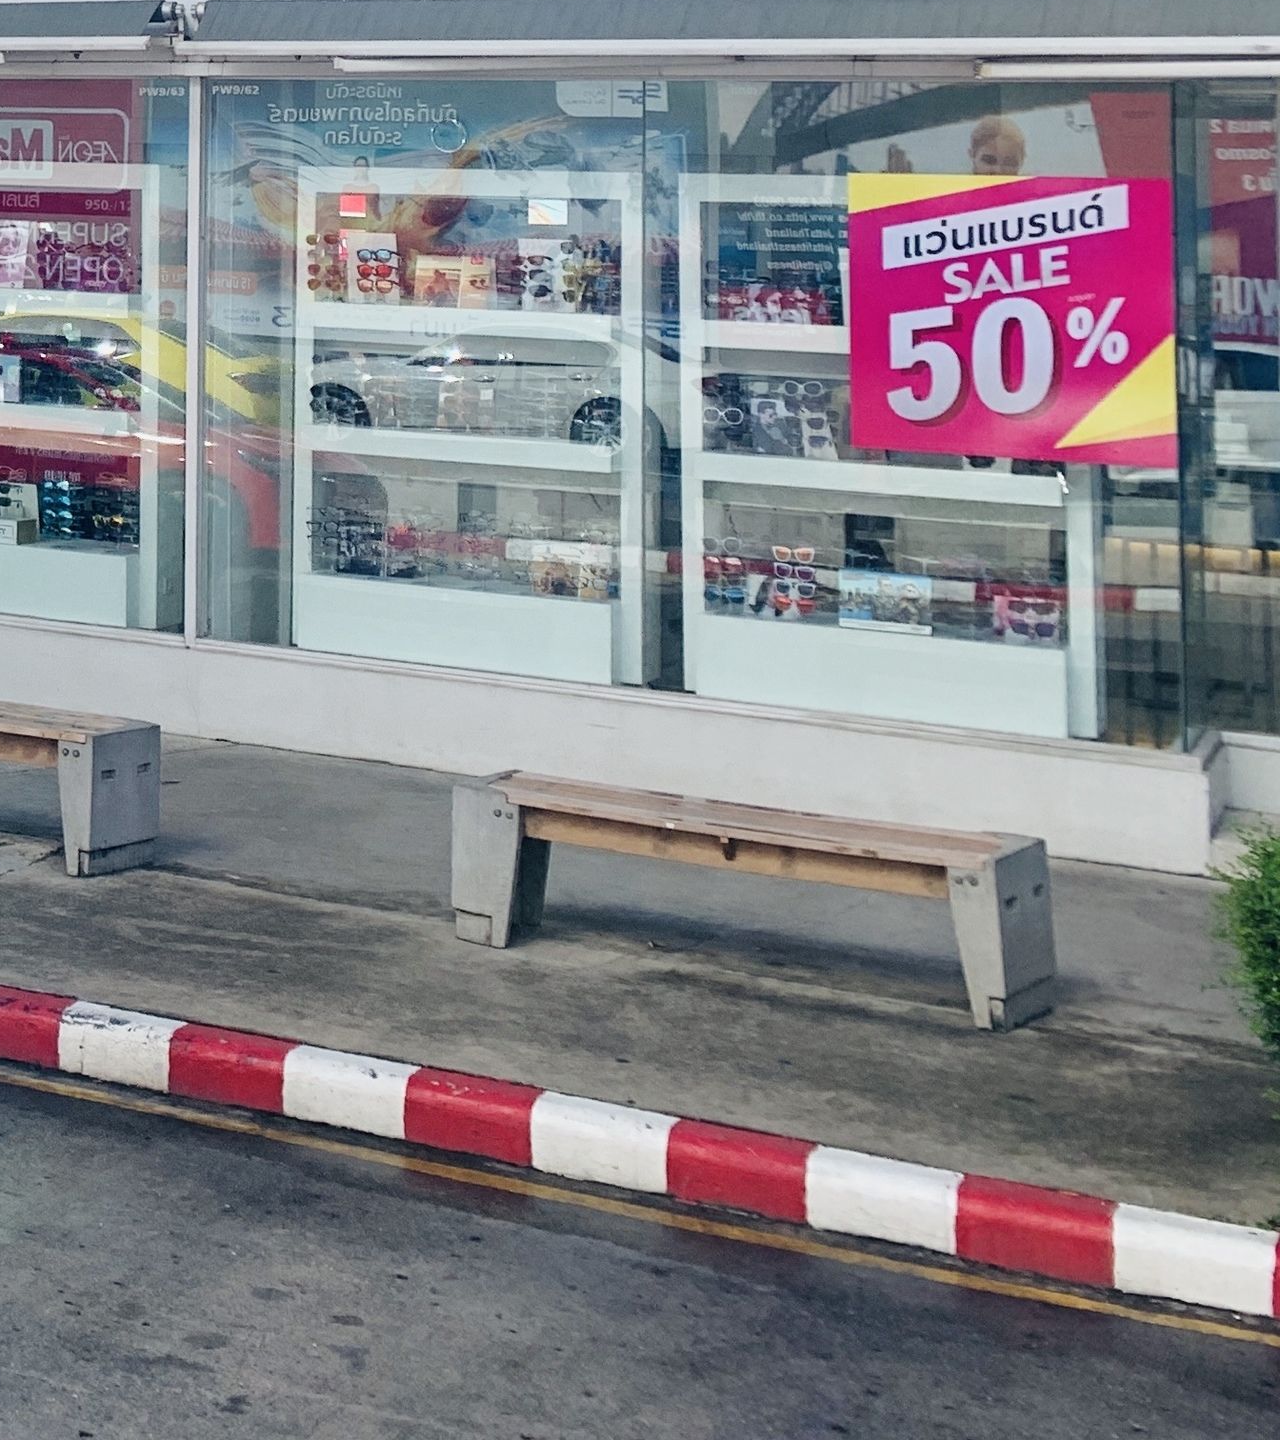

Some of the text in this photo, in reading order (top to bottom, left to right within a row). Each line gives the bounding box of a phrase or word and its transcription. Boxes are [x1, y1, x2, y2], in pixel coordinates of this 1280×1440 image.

[211, 85, 260, 96] PW9/62
[903, 193, 1104, 259] แว่นแบรนด์
[942, 245, 1071, 304] SALE
[886, 296, 1129, 422] 50%
